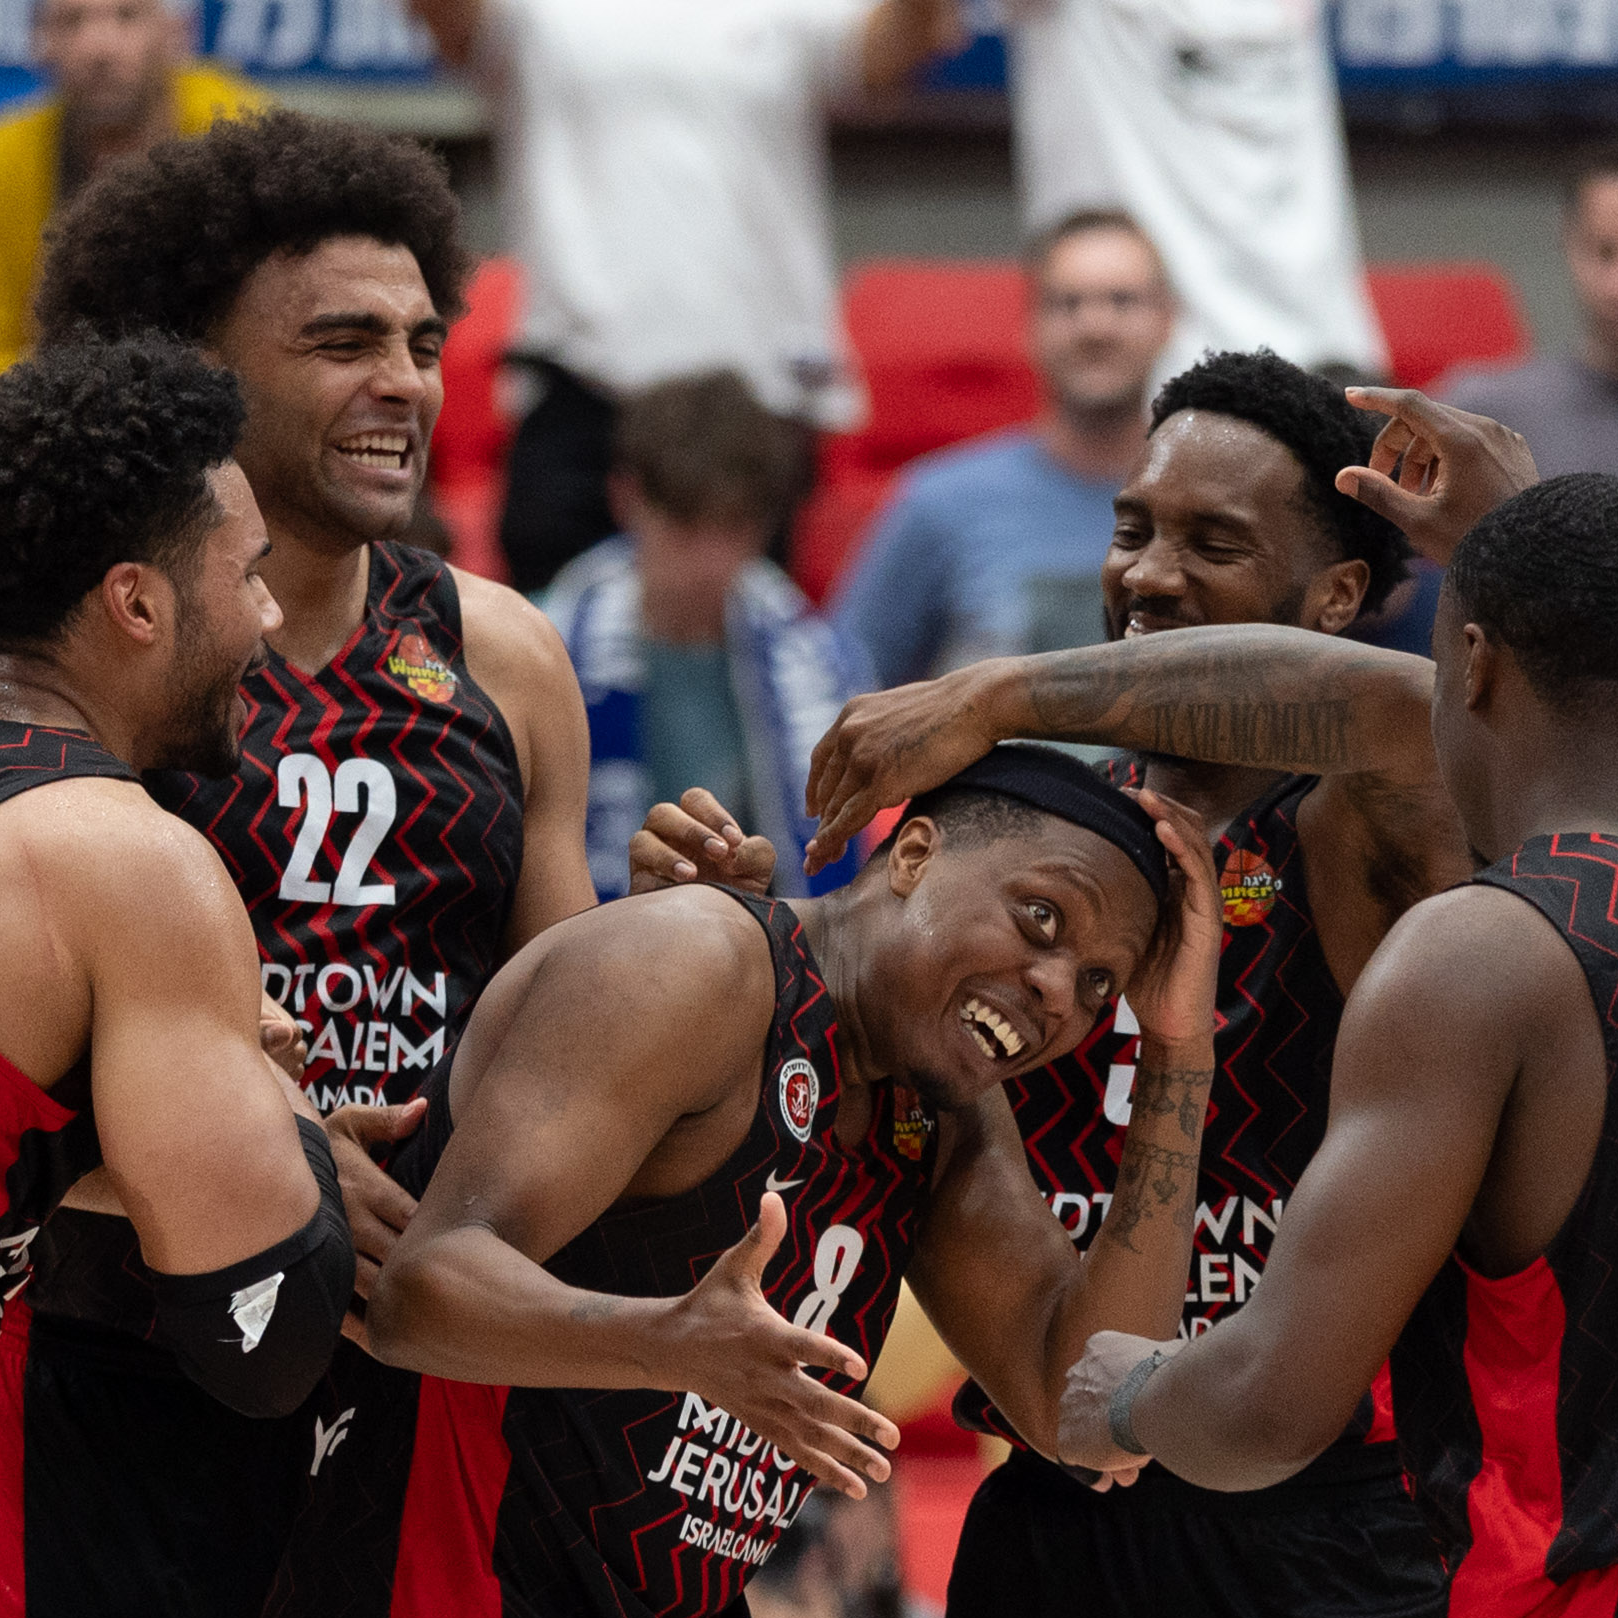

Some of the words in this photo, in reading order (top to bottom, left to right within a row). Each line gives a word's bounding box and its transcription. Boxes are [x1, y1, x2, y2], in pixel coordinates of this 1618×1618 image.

[278, 753, 397, 905] 22
[261, 963, 446, 1018] DTOWN
[793, 1224, 864, 1367] 8
[647, 1436, 814, 1528] JERUSAL
